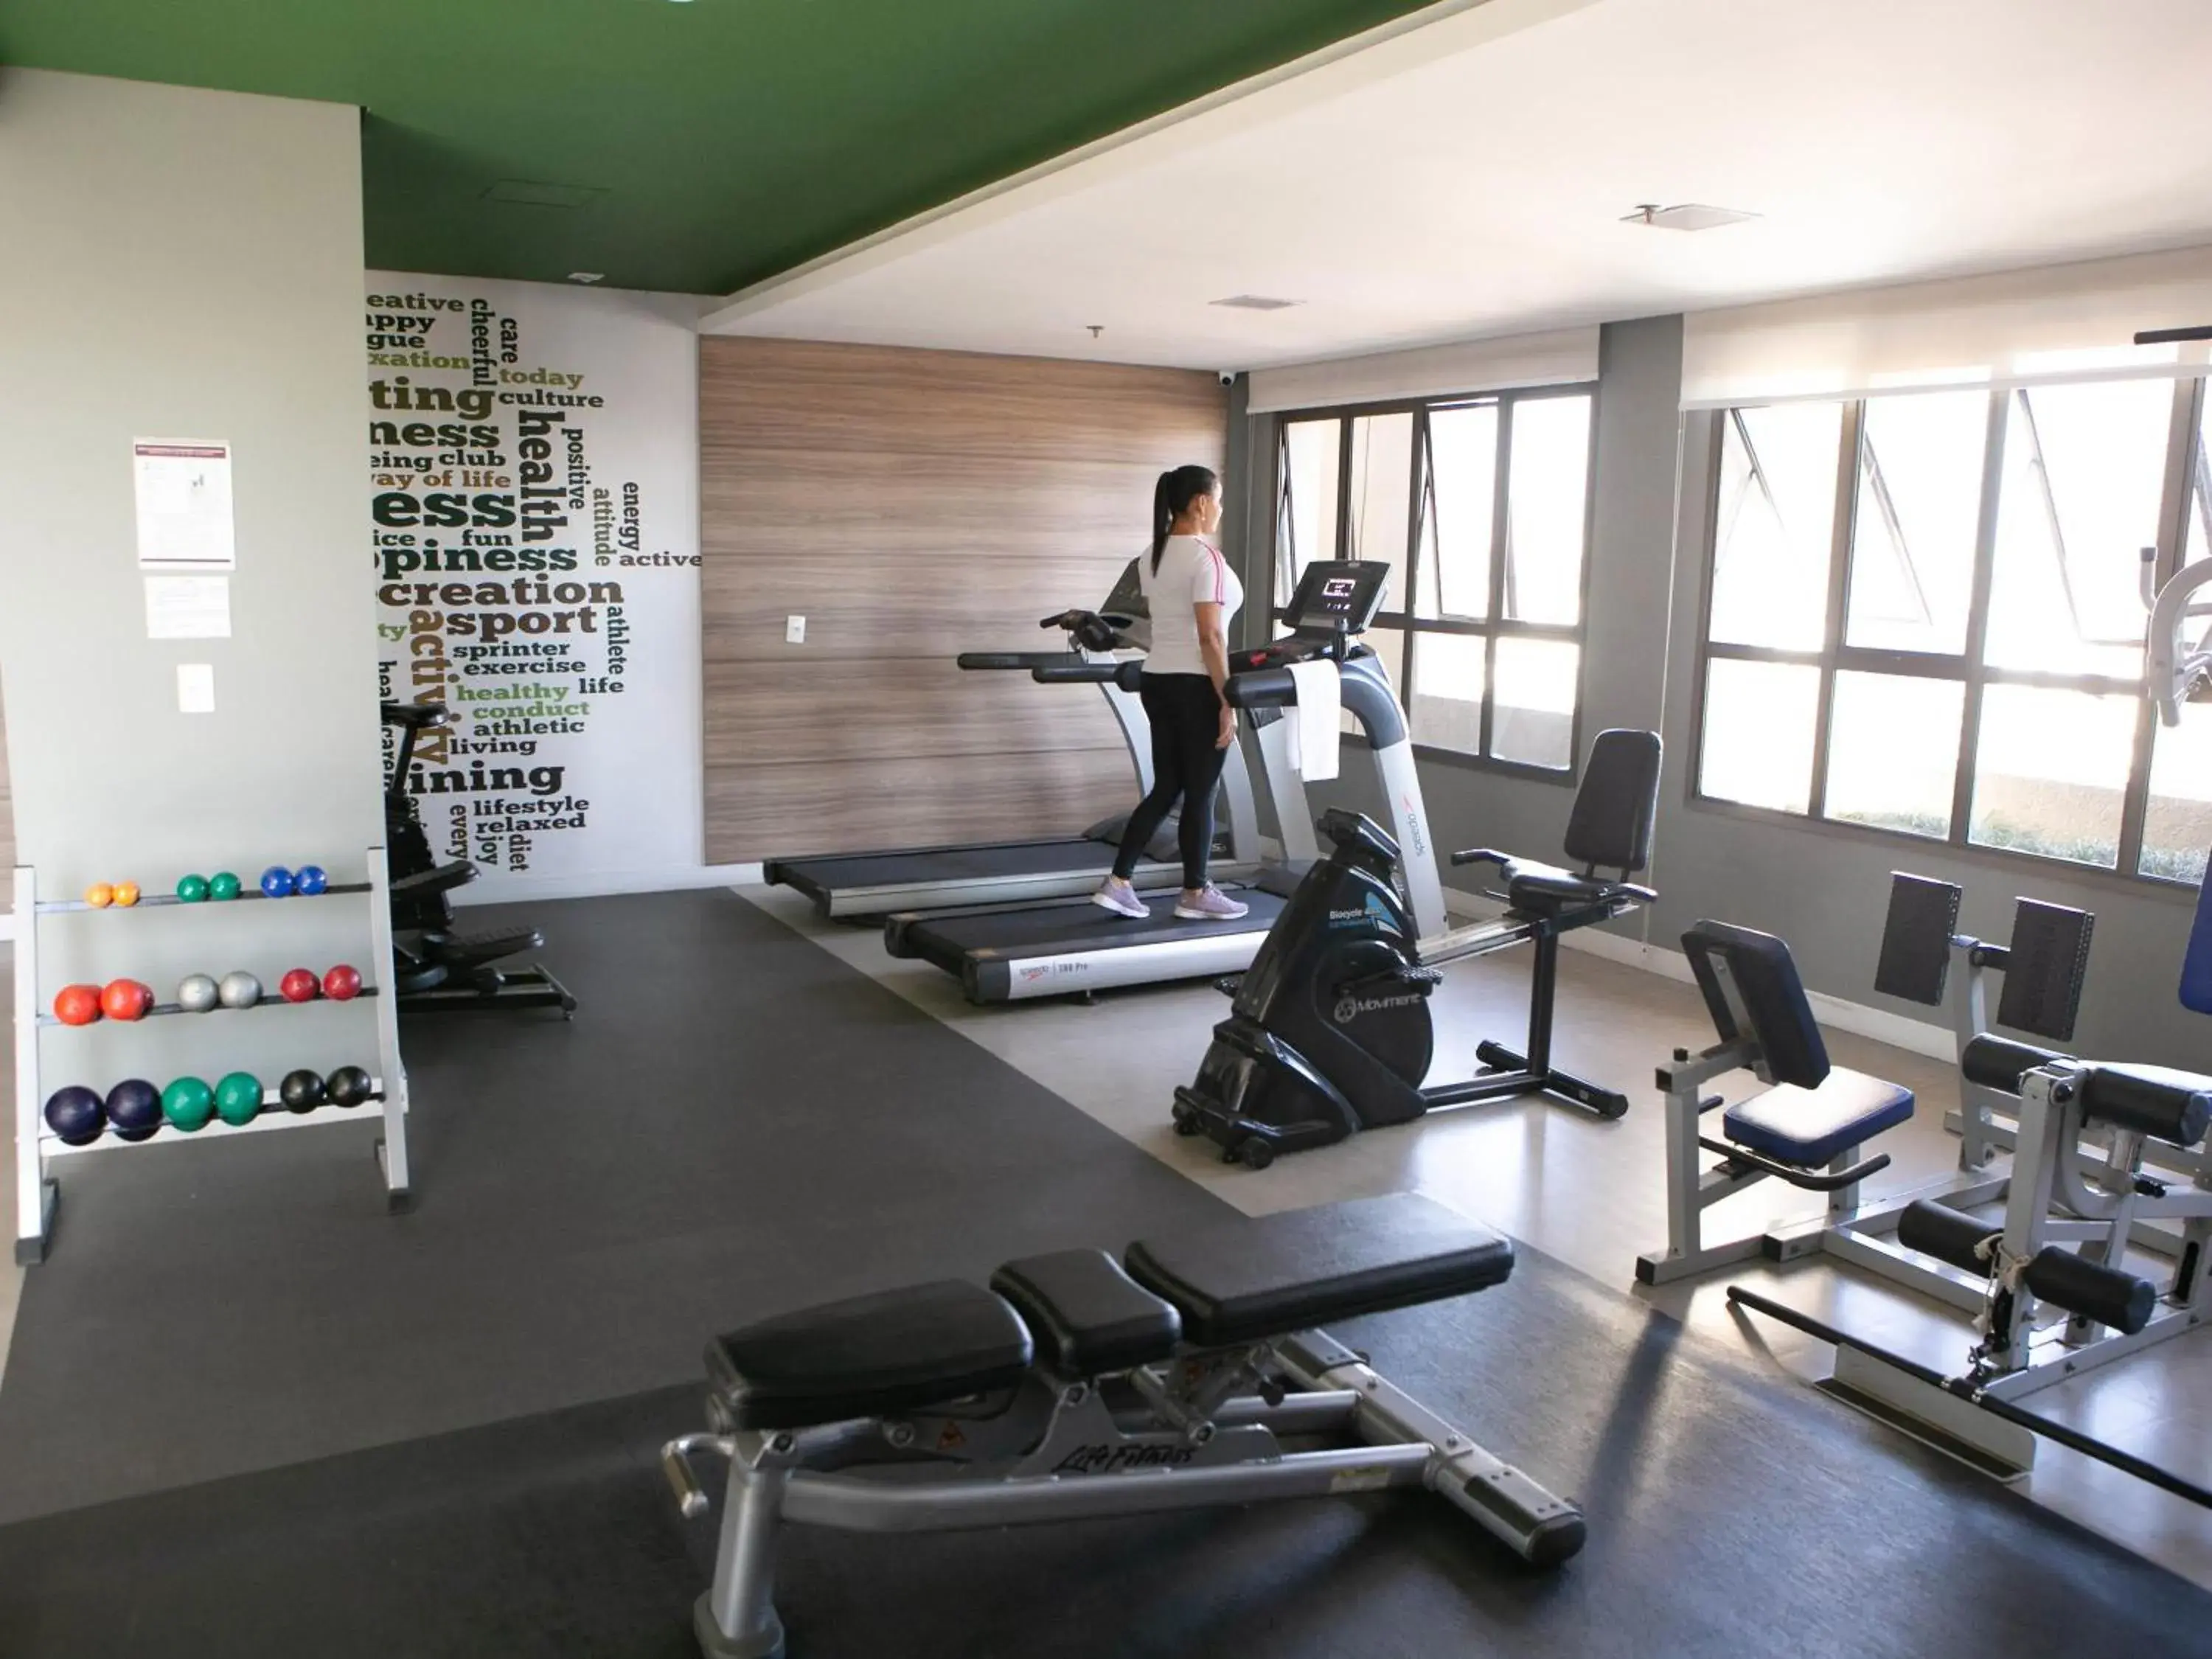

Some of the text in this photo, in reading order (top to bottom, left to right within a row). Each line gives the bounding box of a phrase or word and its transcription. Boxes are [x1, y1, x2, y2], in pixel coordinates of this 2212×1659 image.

[366, 293, 464, 312] eative
[366, 334, 425, 349] gue
[471, 299, 498, 386] cheerful
[500, 318, 518, 364] care
[368, 350, 470, 369] xation
[500, 369, 584, 389] today
[369, 377, 495, 420] ting
[498, 389, 603, 408] culture
[370, 421, 499, 448] ness
[439, 451, 506, 467] club
[561, 428, 591, 509] positive
[371, 470, 511, 490] ay of life
[519, 411, 568, 542] health
[372, 492, 517, 528] ess
[618, 481, 639, 552] energy
[593, 487, 617, 566] attitude
[462, 530, 513, 546] fun
[619, 551, 703, 568] active
[378, 573, 624, 607] creation
[446, 606, 597, 643] sport
[608, 605, 630, 675] athlete
[452, 641, 571, 660] sprinter
[463, 657, 586, 676] exercise
[409, 610, 462, 765] activty
[456, 683, 570, 701] healthy
[579, 678, 624, 695] life
[473, 700, 590, 720] conduct
[473, 718, 585, 737] athletic
[451, 738, 538, 756] living
[408, 760, 564, 796] ining
[473, 797, 590, 816] lifestyle
[445, 804, 468, 860] every
[476, 815, 586, 834] relaxed
[475, 835, 504, 866] joy
[509, 834, 532, 872] diet
